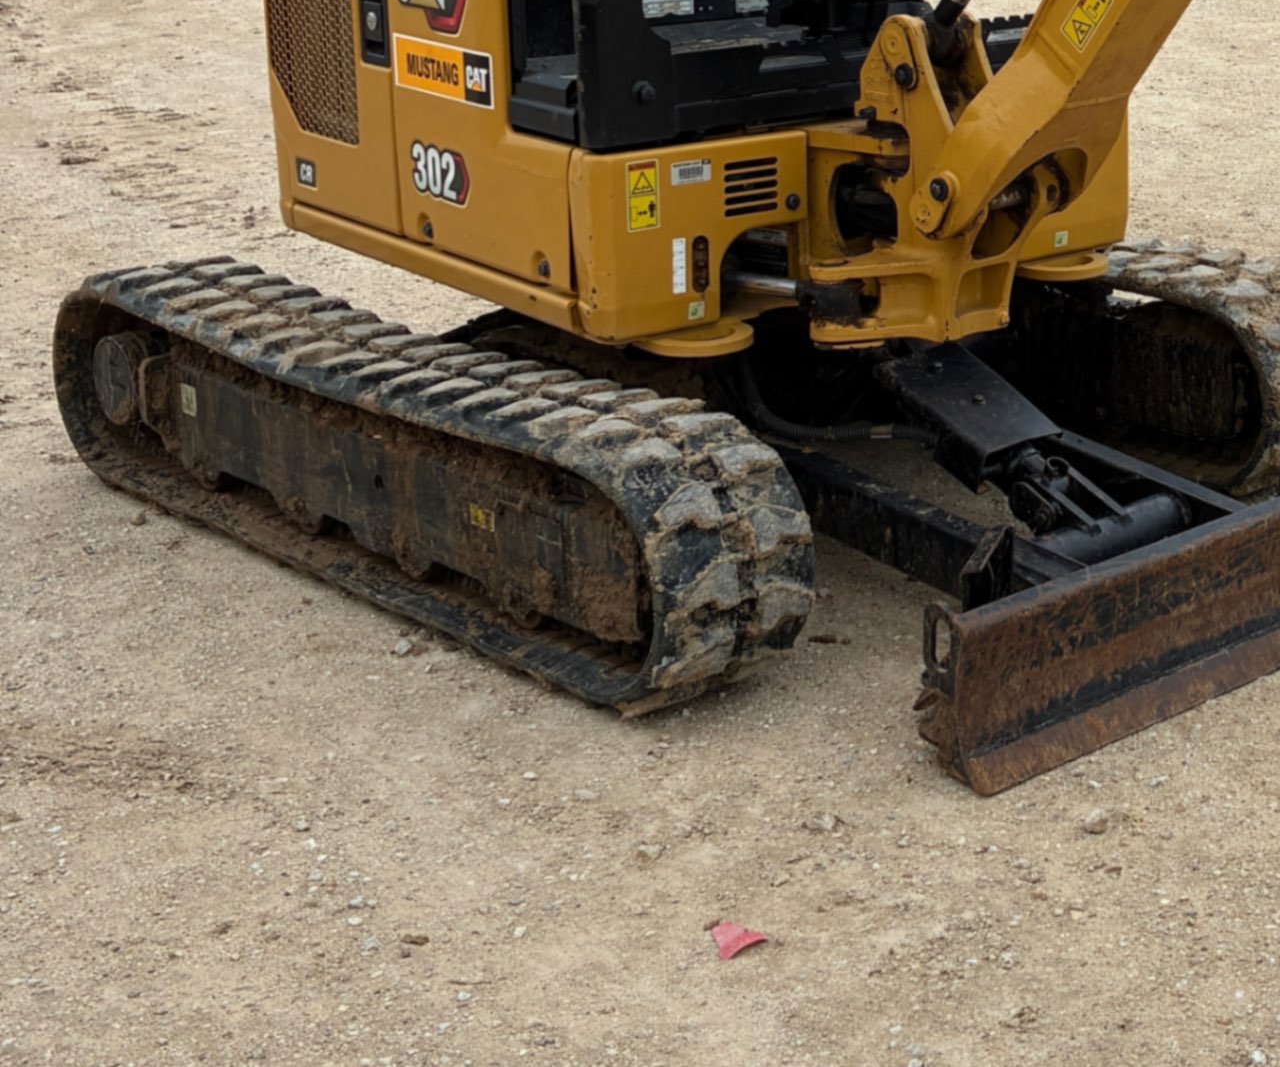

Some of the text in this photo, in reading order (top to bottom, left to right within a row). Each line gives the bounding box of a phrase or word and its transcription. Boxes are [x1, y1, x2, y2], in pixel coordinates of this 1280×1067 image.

[406, 52, 488, 92] MUSTANG CAT
[300, 163, 313, 183] CR
[412, 142, 457, 201] 302
